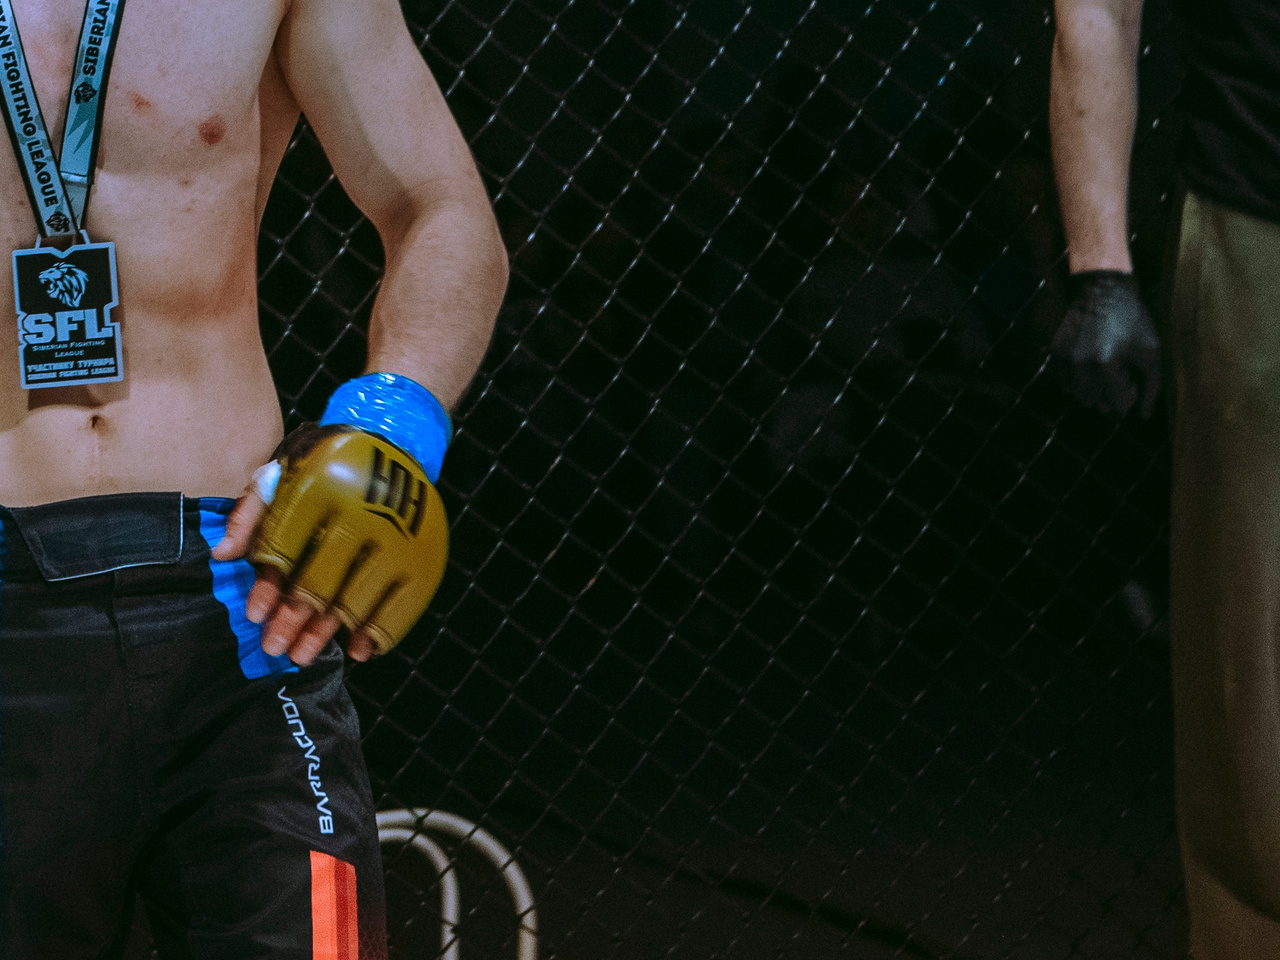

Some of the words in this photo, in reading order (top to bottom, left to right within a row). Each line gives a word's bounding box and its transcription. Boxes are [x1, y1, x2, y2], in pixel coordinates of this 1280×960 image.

[2, 50, 37, 137] FIGHTING
[27, 139, 59, 208] LEAGUE
[23, 308, 113, 344] SFL
[277, 686, 334, 834] BARRACUDA
